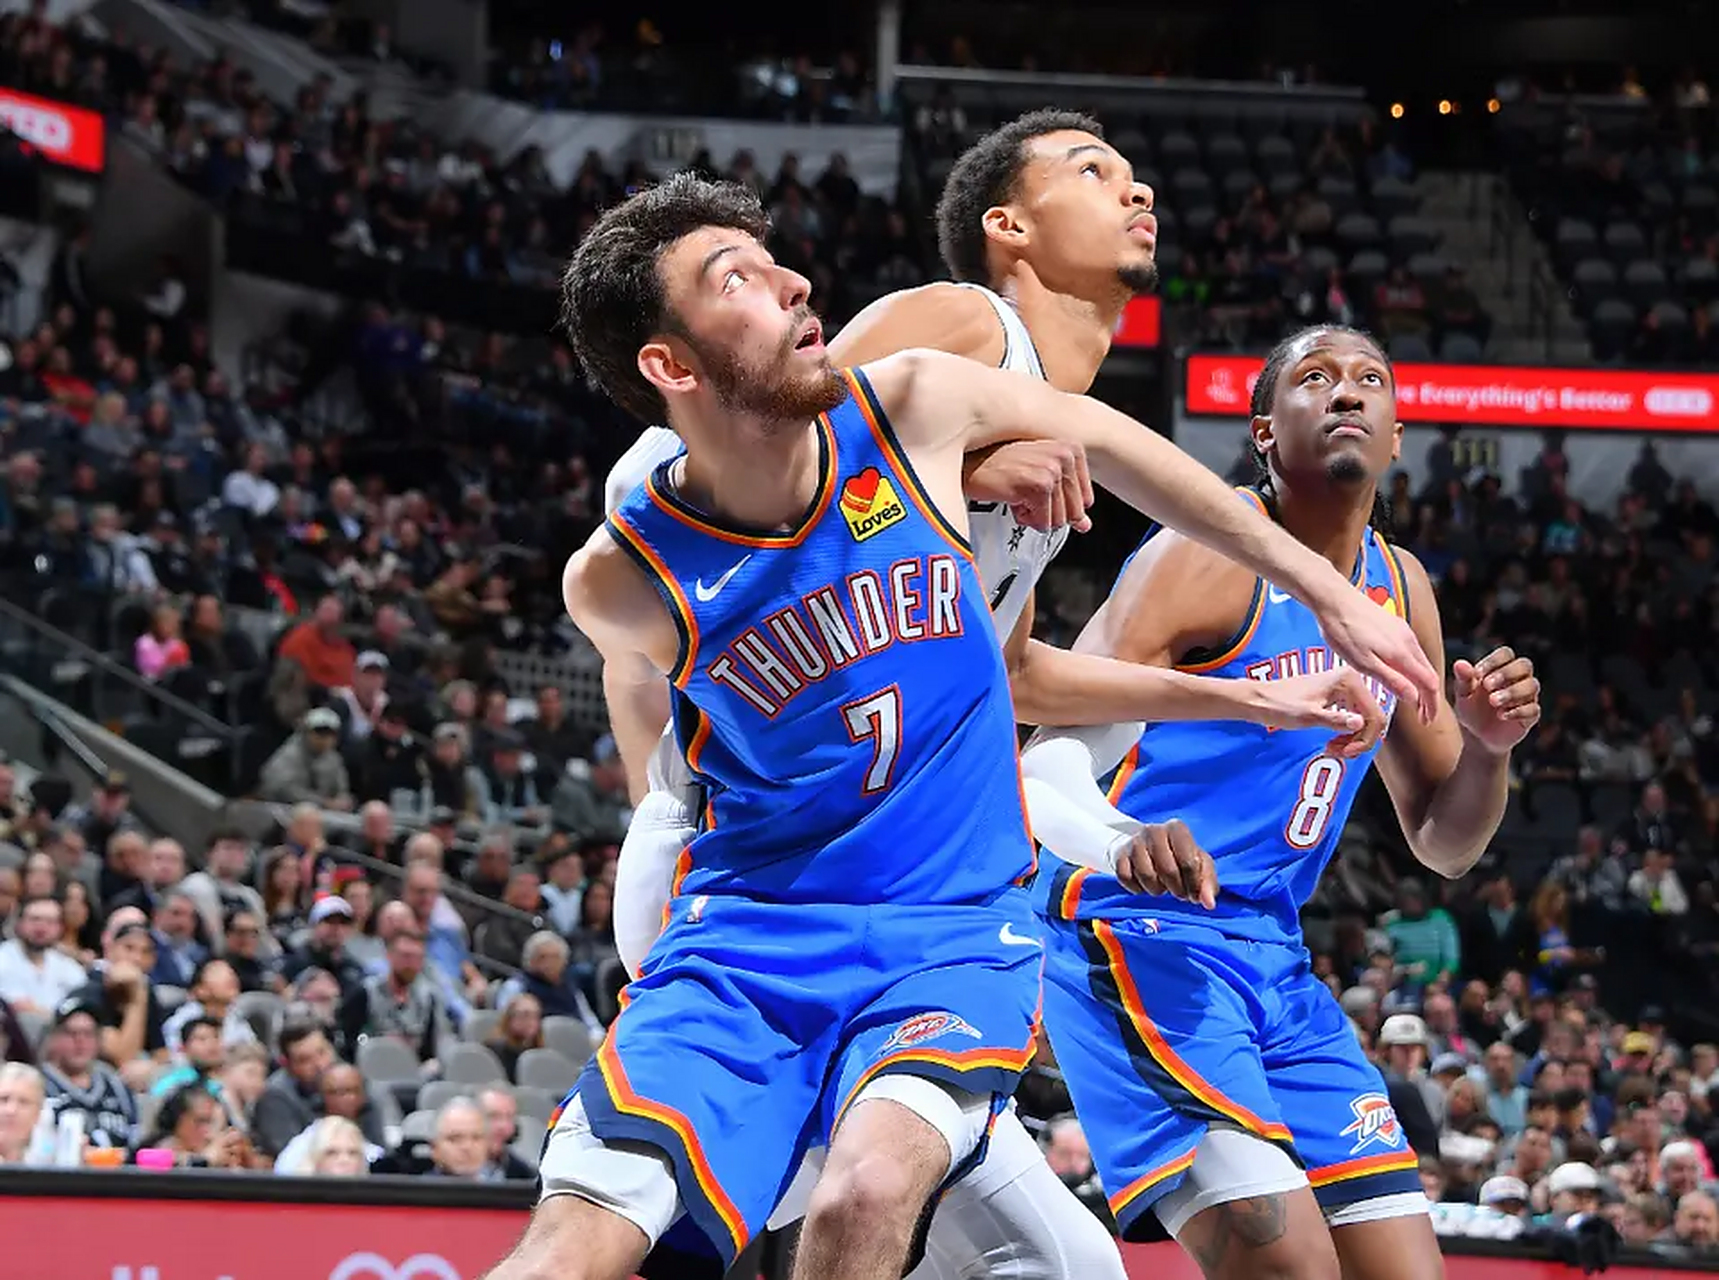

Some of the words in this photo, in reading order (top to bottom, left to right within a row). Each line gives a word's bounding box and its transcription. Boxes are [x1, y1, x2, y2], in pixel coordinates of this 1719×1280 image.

[1420, 382, 1556, 412] Everything's
[1559, 386, 1631, 411] Better
[707, 555, 963, 720] THUNDER
[839, 683, 902, 798] 7
[1284, 754, 1346, 850] 8
